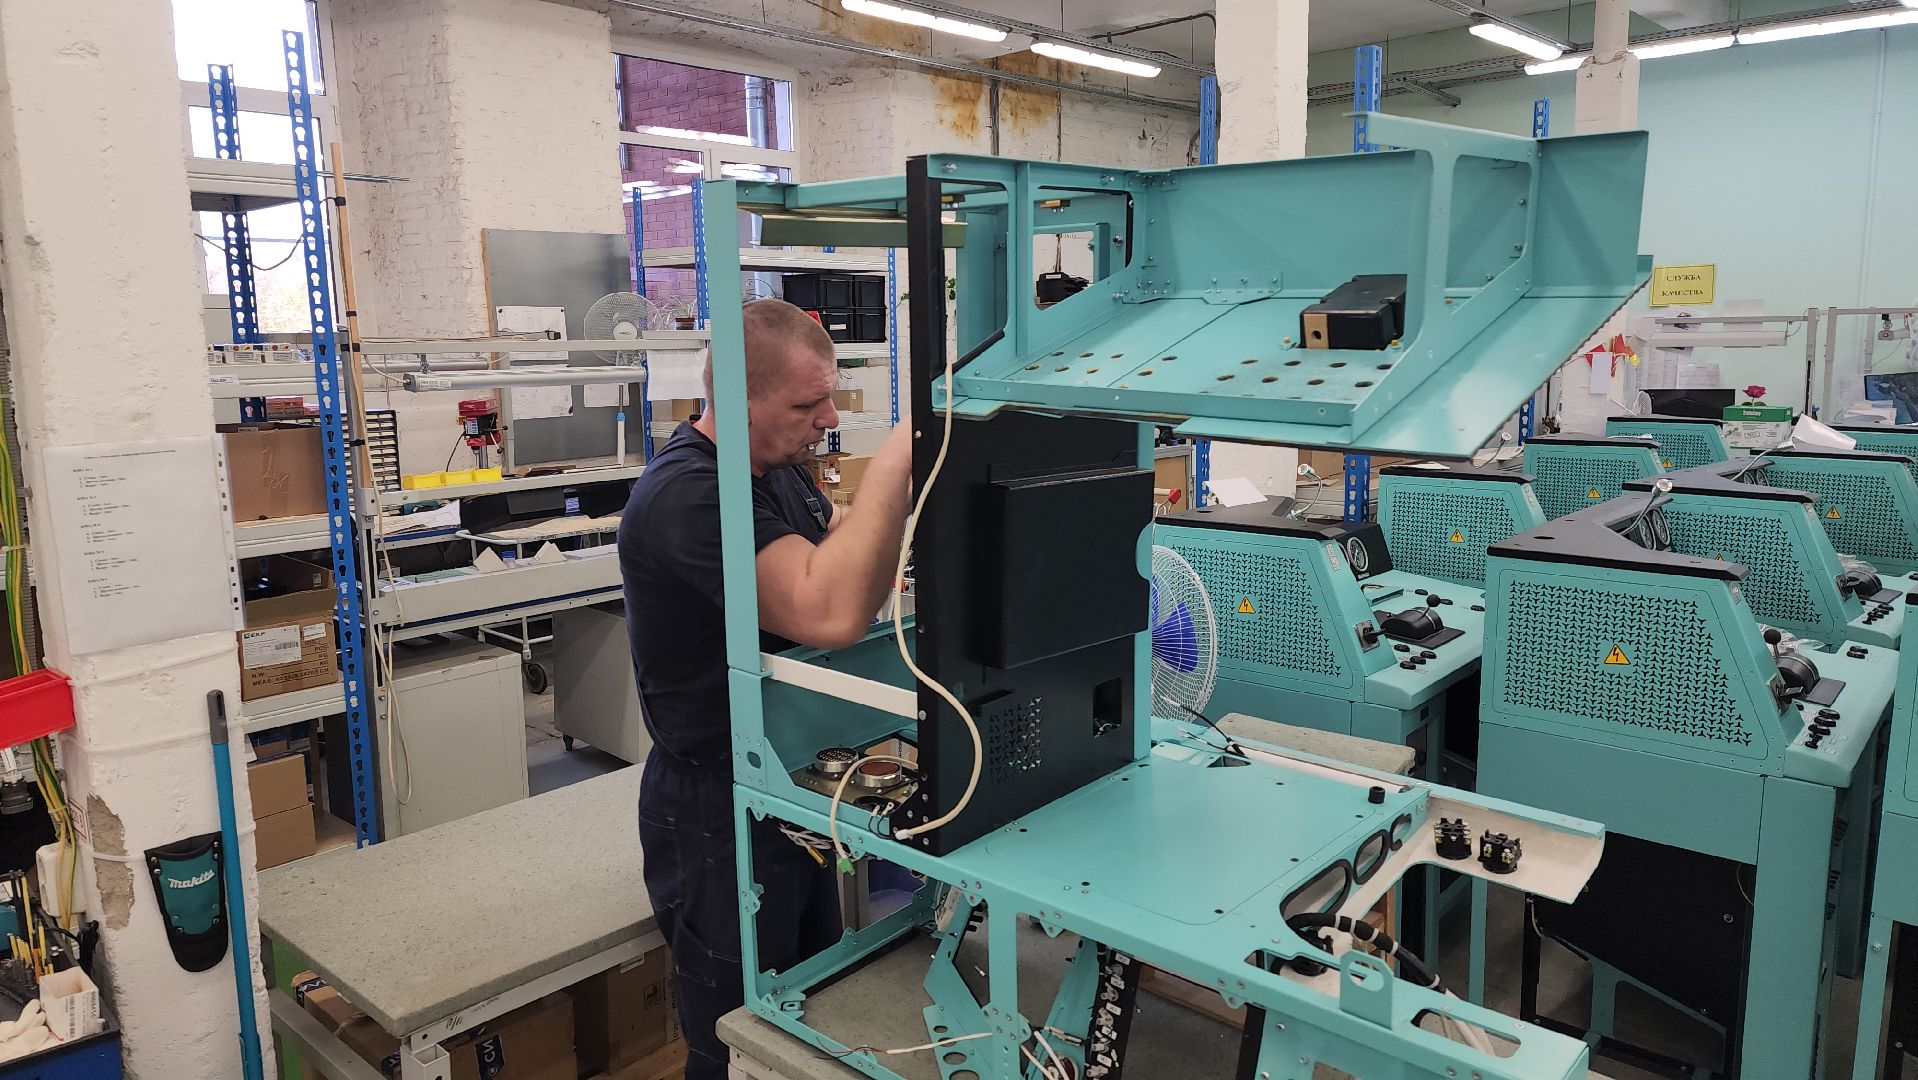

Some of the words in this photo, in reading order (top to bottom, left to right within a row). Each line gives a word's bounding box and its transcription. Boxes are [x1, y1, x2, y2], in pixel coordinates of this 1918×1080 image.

[1666, 274, 1702, 282] СЛУЖБА
[1661, 289, 1704, 297] КАЧЕСТВА
[167, 869, 216, 889] makita
